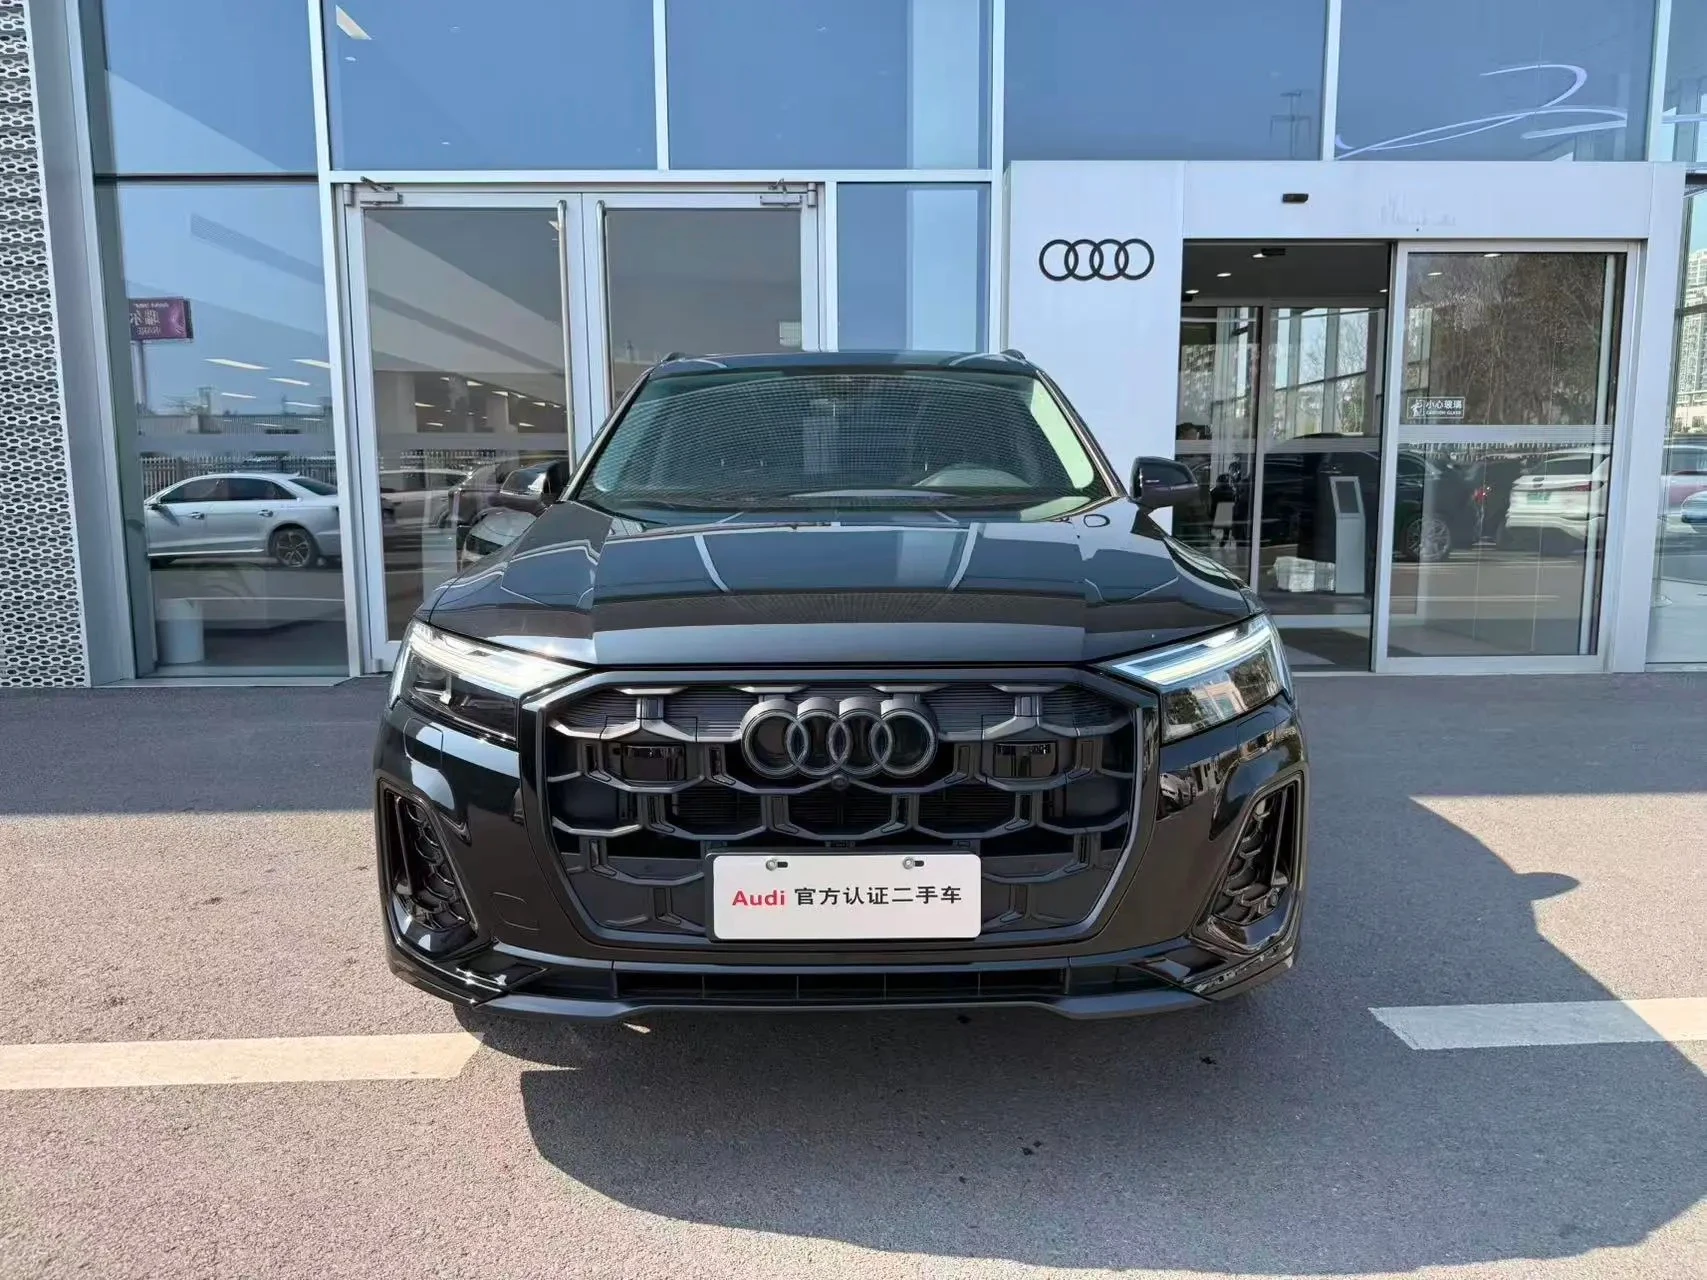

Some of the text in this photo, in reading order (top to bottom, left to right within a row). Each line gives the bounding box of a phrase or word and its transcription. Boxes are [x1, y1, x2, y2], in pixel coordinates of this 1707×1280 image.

[732, 886, 962, 906] Audi 官方认证二手车
